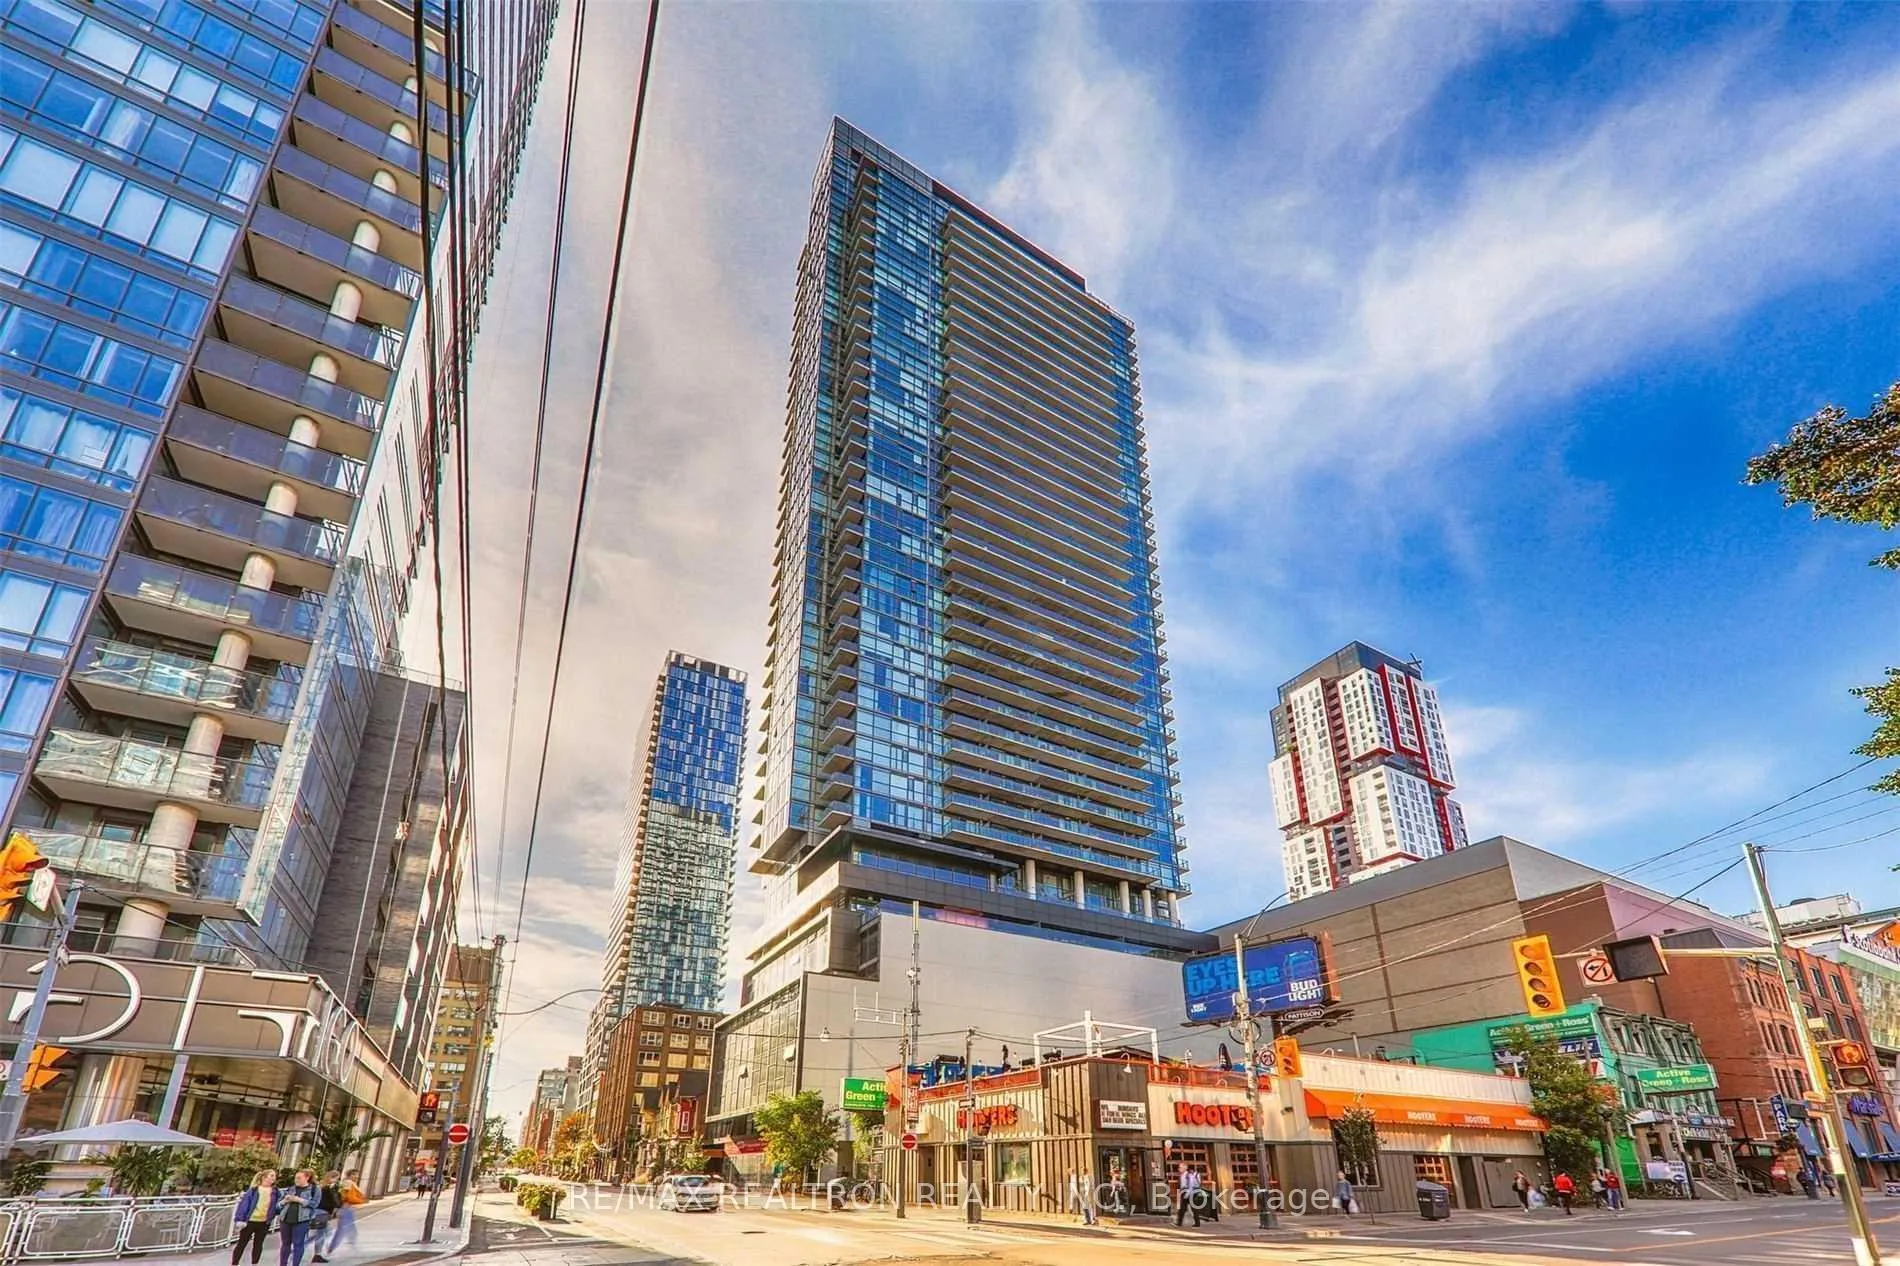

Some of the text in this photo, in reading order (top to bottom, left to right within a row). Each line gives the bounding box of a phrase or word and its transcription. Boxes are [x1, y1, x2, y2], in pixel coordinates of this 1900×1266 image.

[1187, 956, 1237, 979] EYES
[1189, 966, 1280, 995] UP HRE
[1290, 979, 1318, 992] BUD
[1288, 988, 1323, 1001] LIGHT
[1288, 1009, 1321, 1019] PATTISON
[1562, 1017, 1589, 1027] Ross
[1656, 1070, 1691, 1078] Active
[1642, 1079, 1672, 1087] Green
[1681, 1076, 1708, 1084] Ross
[845, 1090, 876, 1101] Green
[1774, 1103, 1789, 1131] PARK
